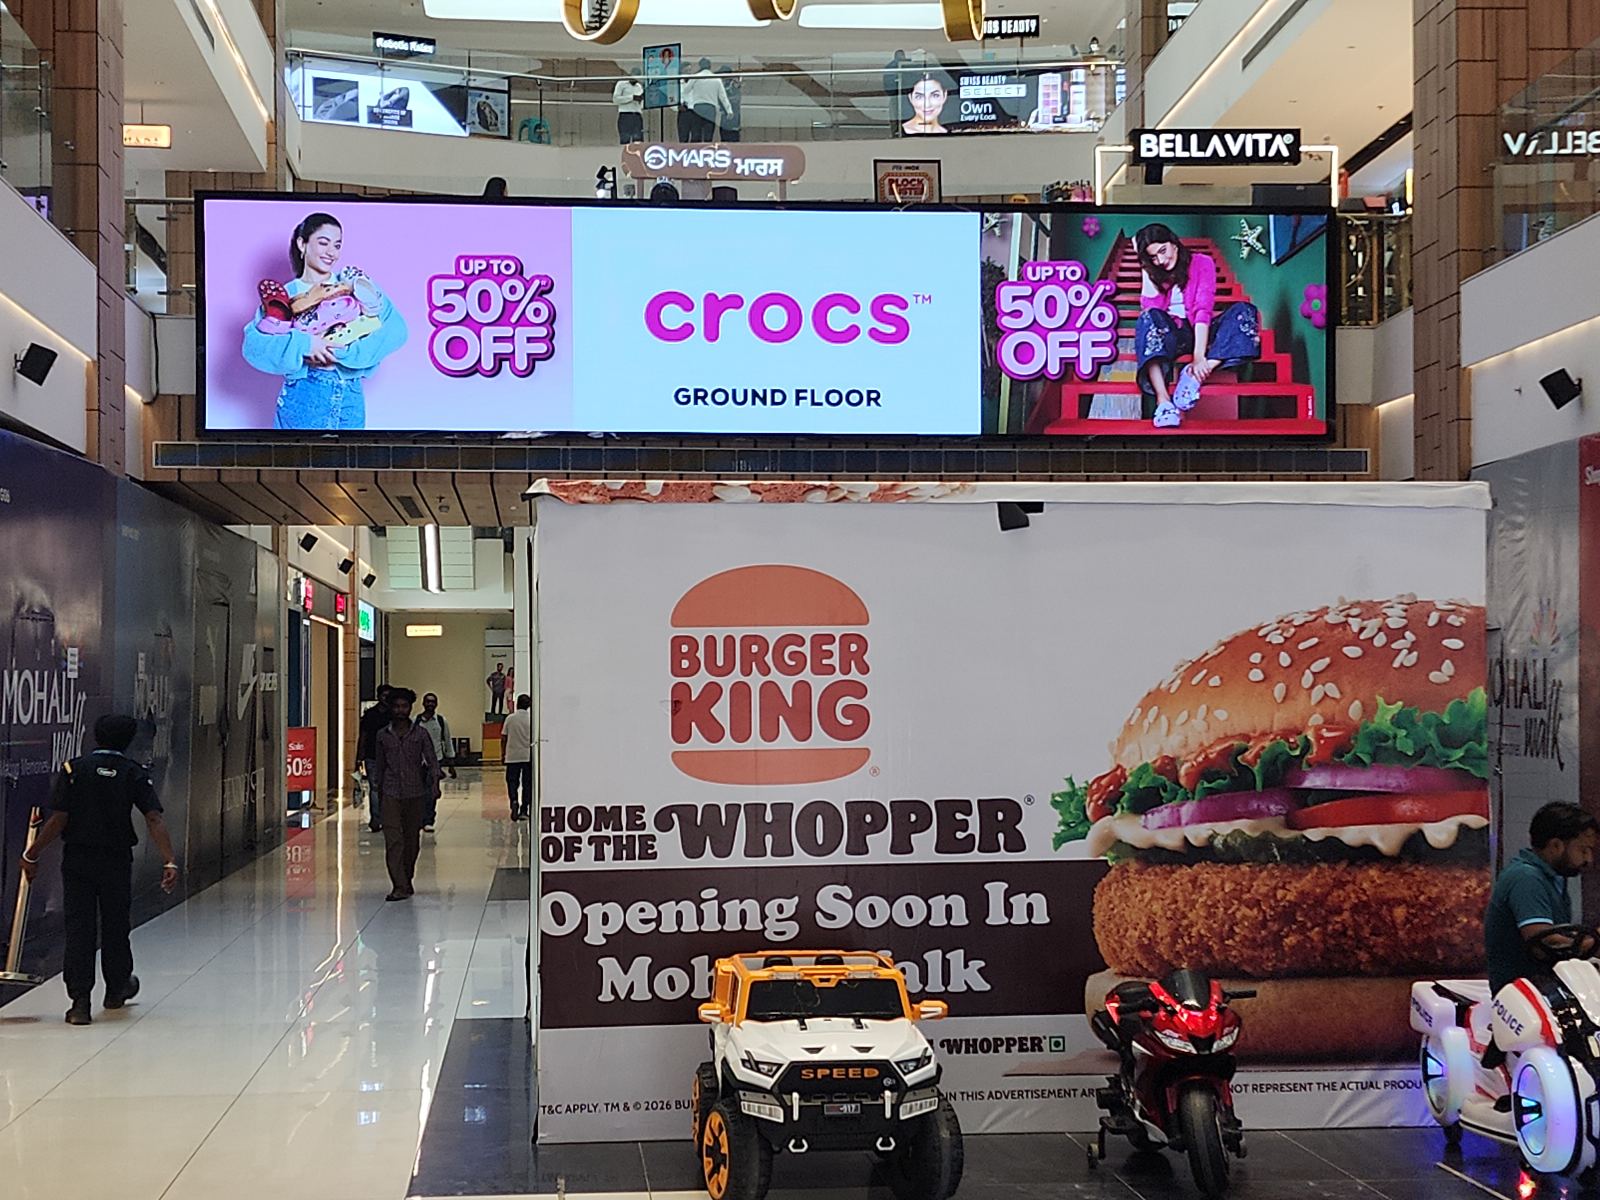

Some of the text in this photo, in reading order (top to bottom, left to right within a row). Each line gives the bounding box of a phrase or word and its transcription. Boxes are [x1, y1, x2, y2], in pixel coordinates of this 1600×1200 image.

[1001, 19, 1037, 34] BEAUTY
[962, 86, 1023, 97] SELECT
[982, 75, 1007, 85] BEAUTY
[961, 101, 992, 115] Own
[668, 149, 732, 168] MARS
[1140, 133, 1290, 158] BELLAVITA
[460, 259, 516, 275] UP TO
[1027, 266, 1082, 281] UP TO
[432, 279, 549, 323] 50%
[1000, 284, 1114, 329] 50%
[644, 291, 911, 344] crocs
[433, 325, 548, 371] OFF
[1001, 331, 1112, 375] OFF
[674, 387, 882, 407] GROUND FLOOR
[670, 633, 871, 678] BURGER
[1, 668, 75, 725] MOHALI
[670, 679, 871, 744] KING
[540, 804, 647, 834] HOME
[653, 798, 1027, 860] WHOPPER
[541, 833, 658, 864] OF THE
[540, 881, 1050, 946] Opening Soon In
[1491, 999, 1524, 1036] POLICE
[939, 1036, 1045, 1055] WHOPPER
[801, 1067, 880, 1079] SPEED
[540, 1103, 562, 1115] T&C
[603, 1102, 620, 1113] TM
[622, 1100, 631, 1112] &
[644, 1100, 672, 1111] 2026
[960, 1090, 985, 1101] THIS
[987, 1088, 1080, 1100] ADVERTISEMENT
[1251, 1082, 1315, 1093] REPRESENT
[1315, 1081, 1338, 1092] THE
[1339, 1080, 1381, 1091] ACTUAL
